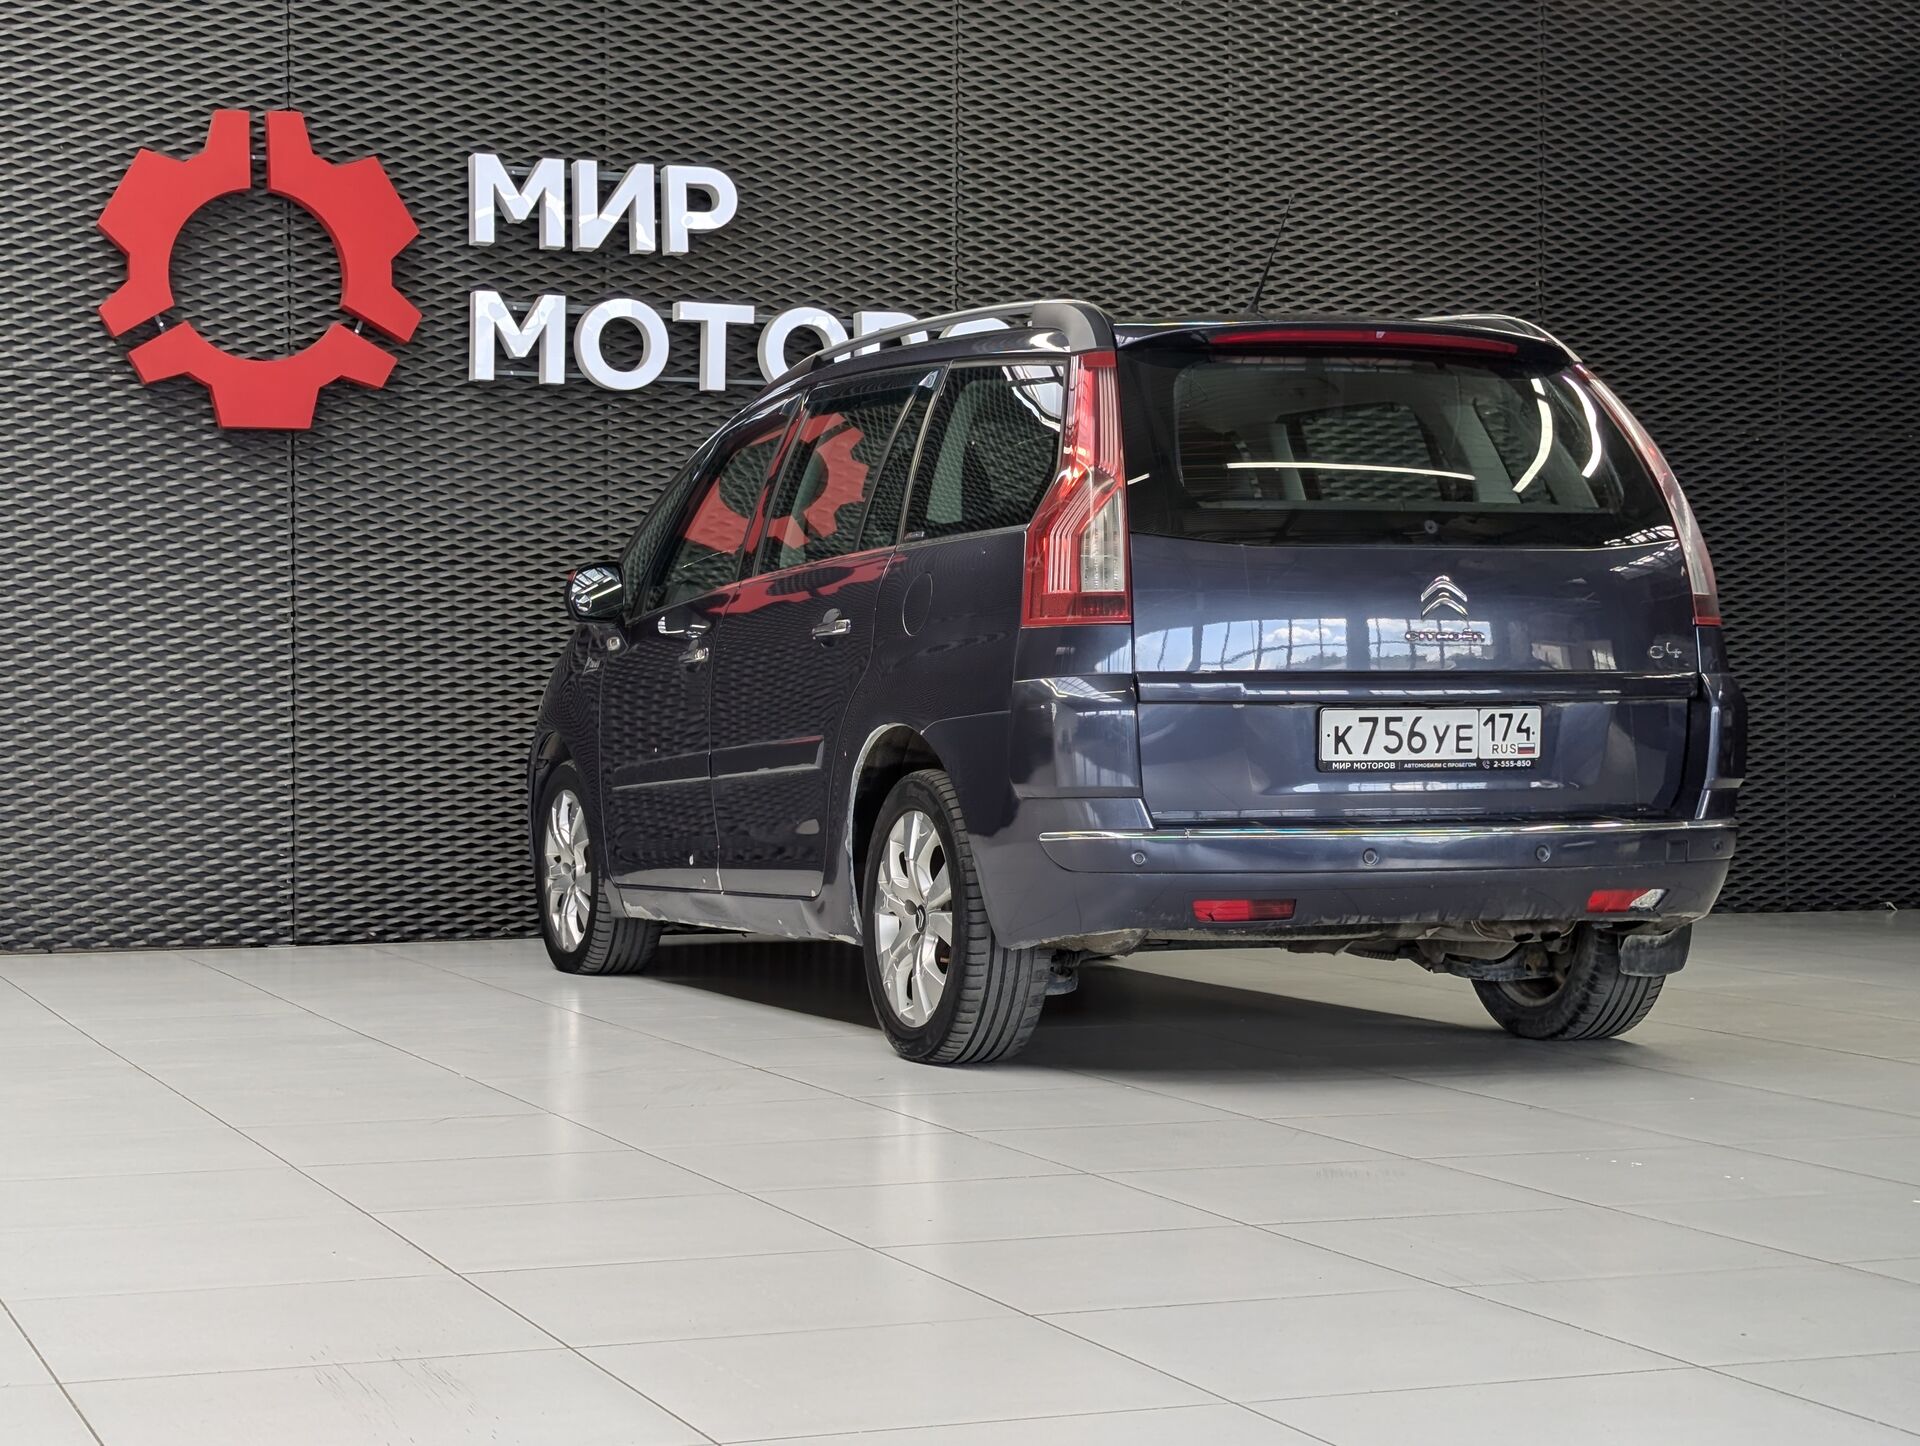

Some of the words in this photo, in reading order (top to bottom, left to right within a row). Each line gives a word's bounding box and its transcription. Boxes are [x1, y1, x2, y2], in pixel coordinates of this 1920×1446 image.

[467, 152, 738, 256] МИР
[1649, 641, 1682, 659] C4
[1333, 716, 1473, 755] К756УЕ
[1482, 712, 1531, 742] 174
[1491, 743, 1517, 754] RUS
[1332, 761, 1351, 770] МИР
[1353, 761, 1396, 770] МОТОРОВ
[1493, 760, 1532, 768] 2-555-850
